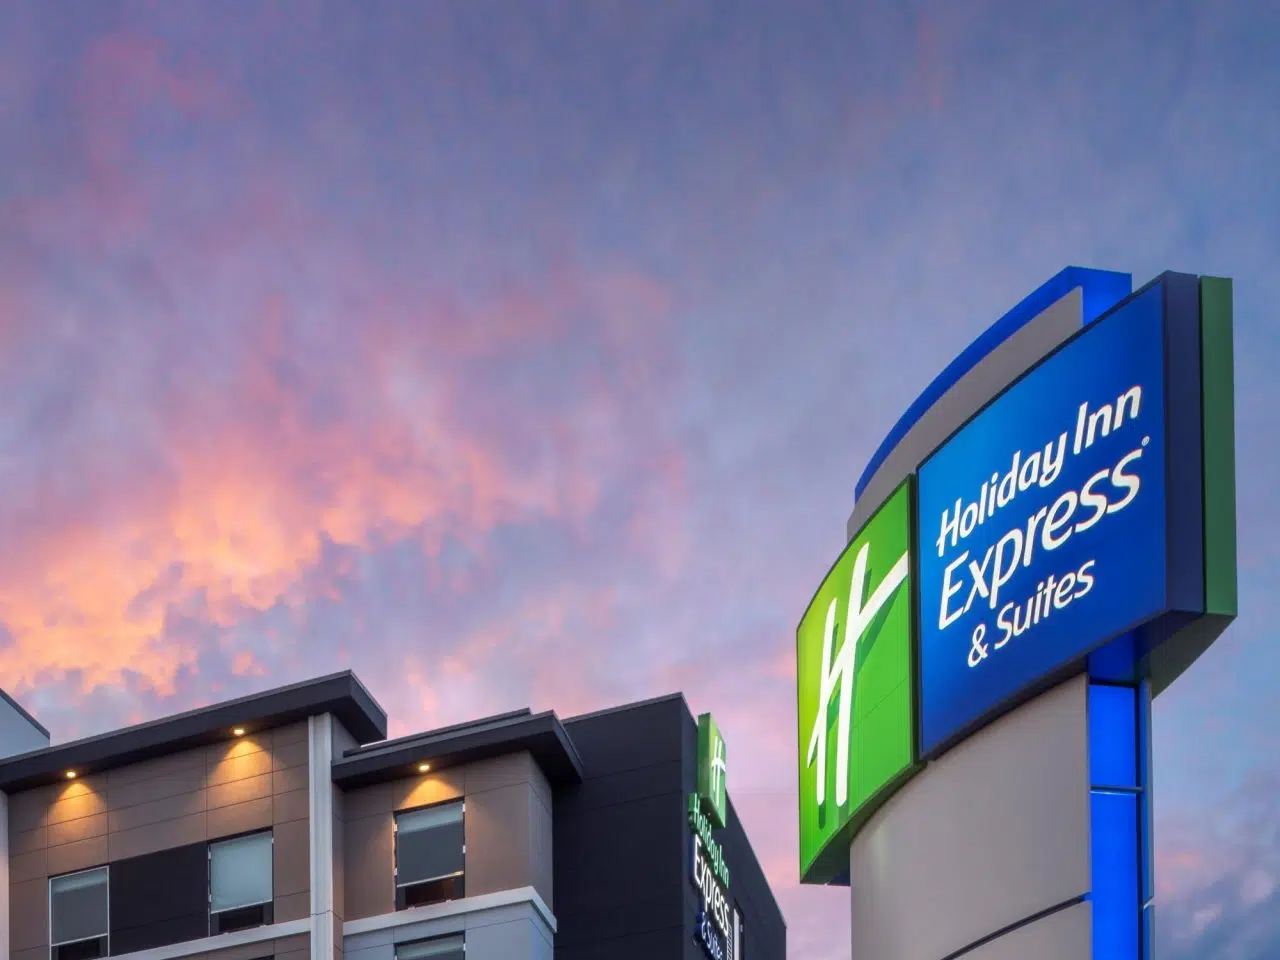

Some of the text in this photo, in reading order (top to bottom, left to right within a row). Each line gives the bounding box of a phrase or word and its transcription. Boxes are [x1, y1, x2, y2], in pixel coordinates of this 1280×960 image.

[935, 384, 1143, 558] Holiday Inn
[937, 447, 1143, 631] Express
[966, 559, 1096, 669] & Suites
[694, 792, 730, 890] Holiday Inn
[694, 833, 730, 938] Express
